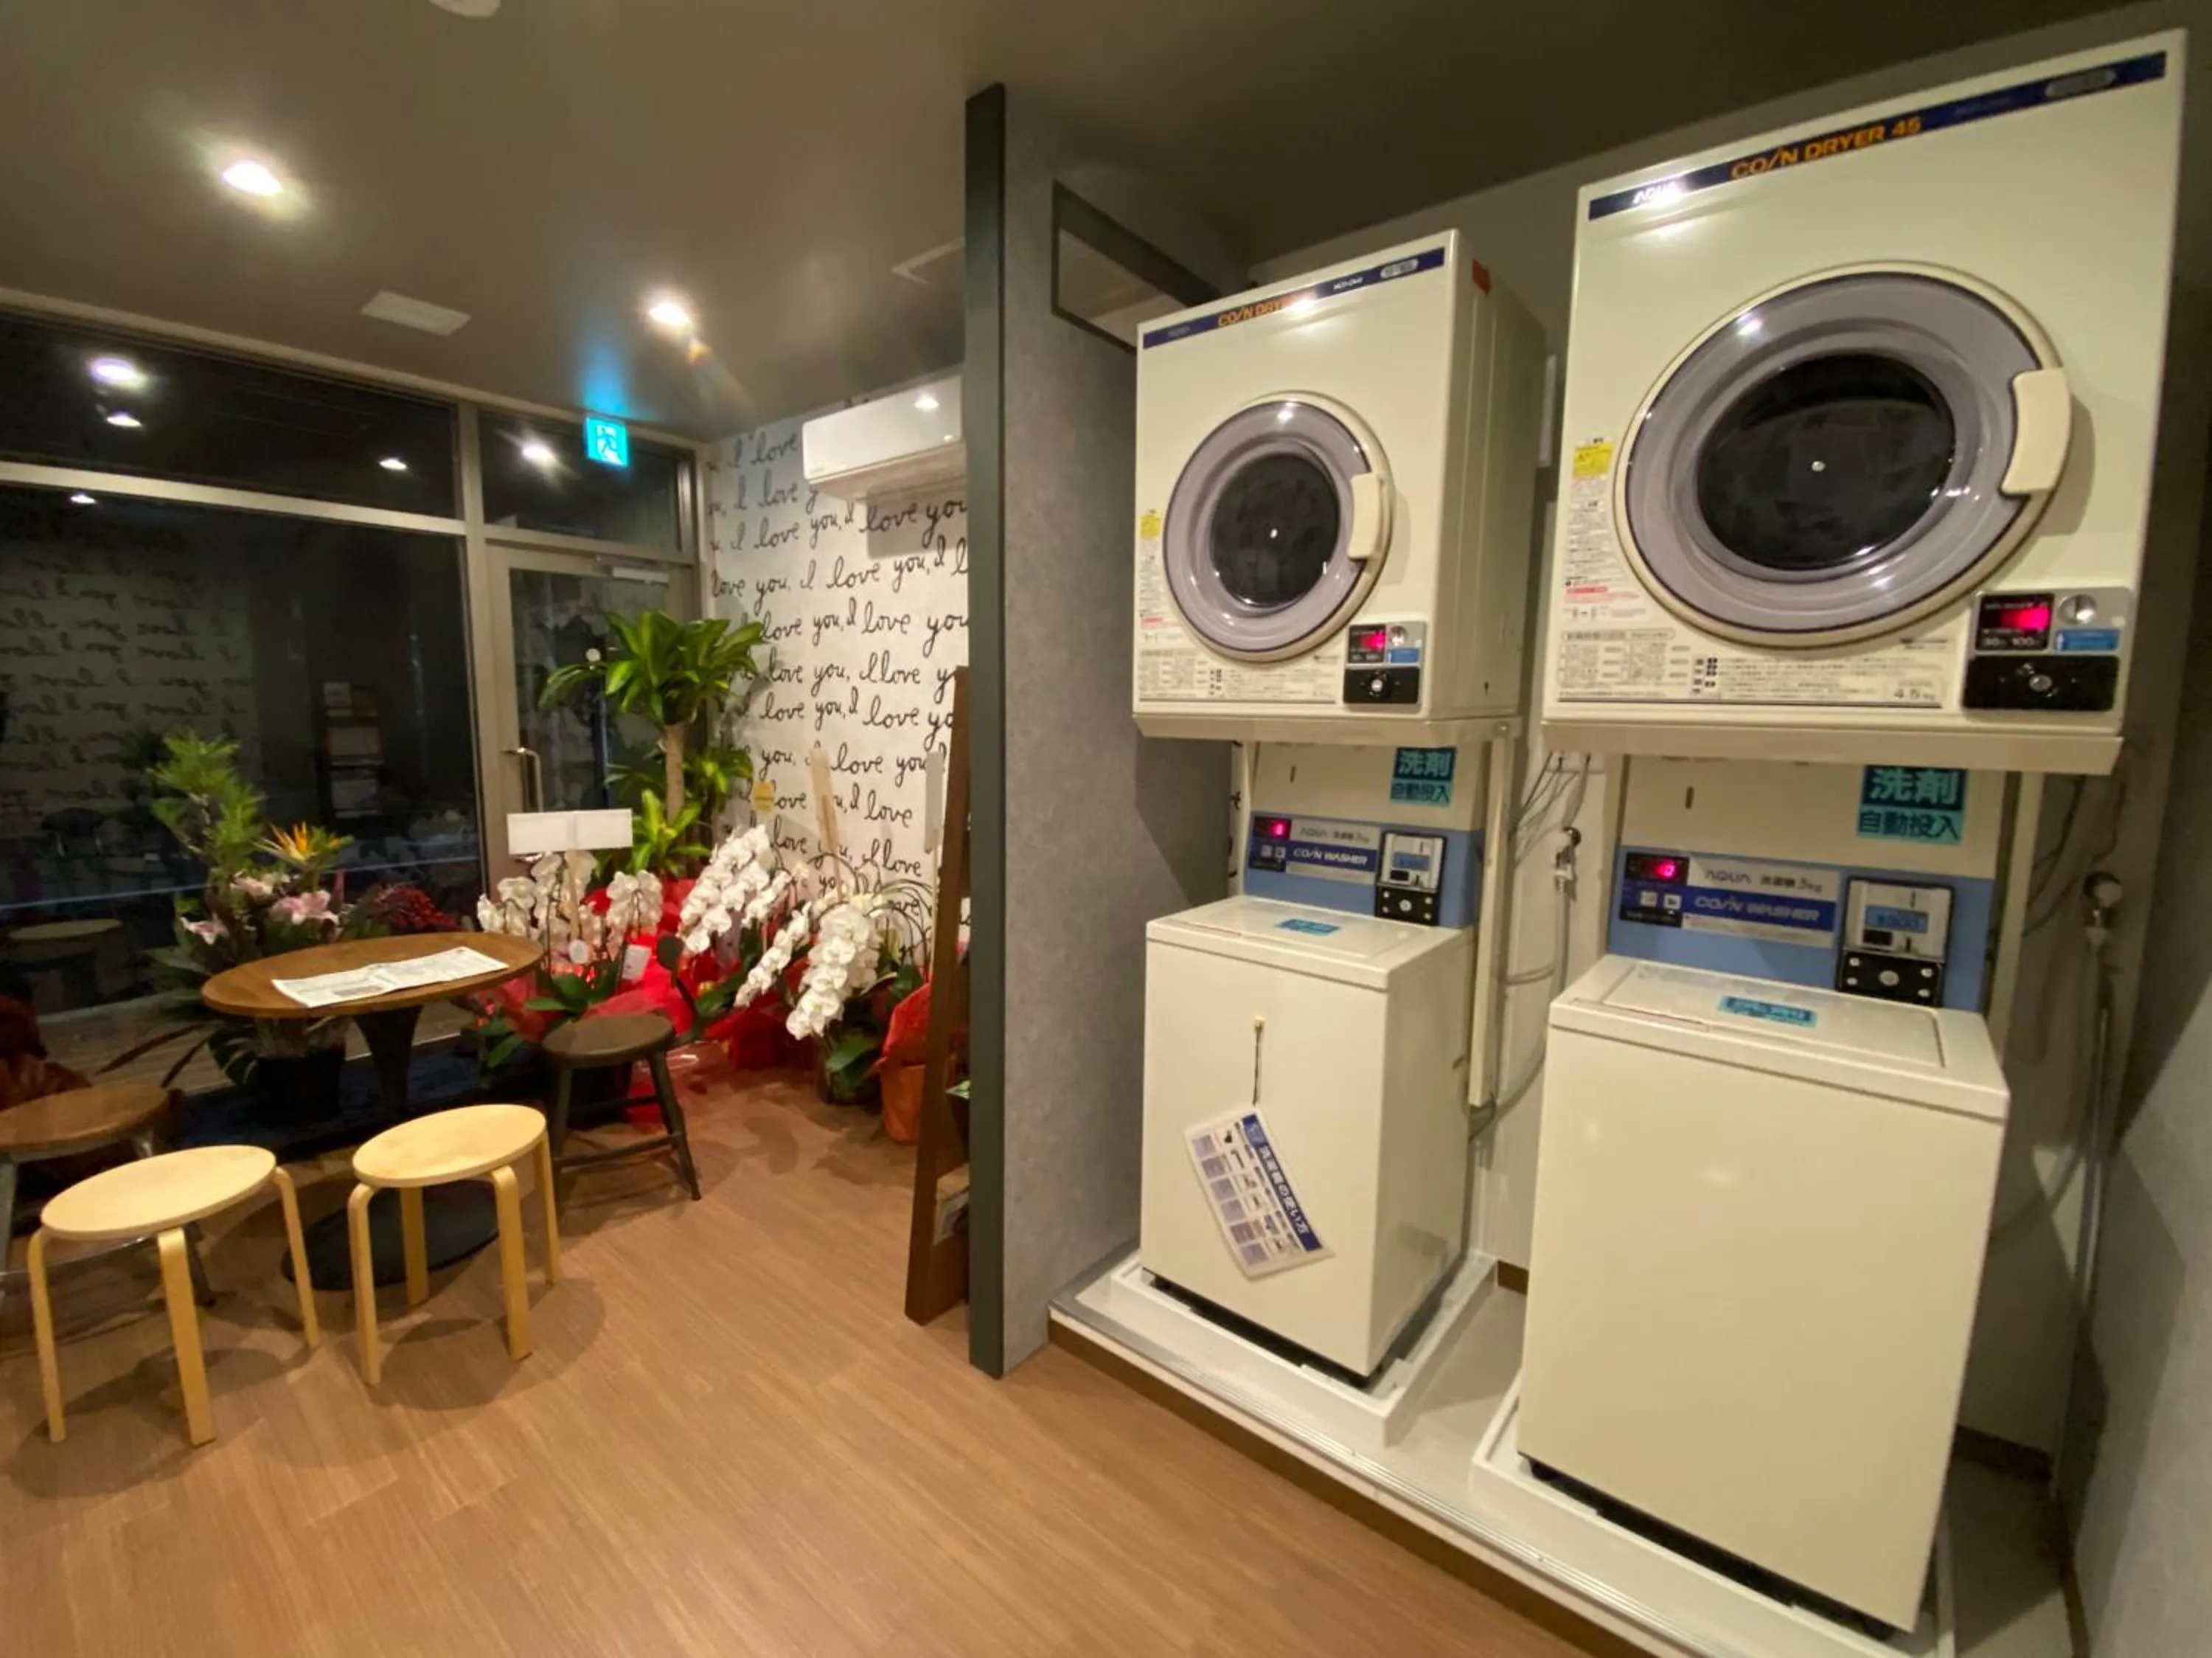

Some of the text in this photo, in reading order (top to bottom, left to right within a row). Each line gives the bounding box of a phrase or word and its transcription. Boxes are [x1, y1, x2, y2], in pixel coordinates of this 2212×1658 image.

[1804, 125, 1885, 162] DRYER
[1890, 116, 1923, 138] 45
[757, 469, 799, 507] love
[754, 518, 801, 549] love
[858, 502, 918, 533] love
[826, 555, 880, 589] love
[760, 611, 802, 640] love
[861, 601, 911, 634] love
[764, 647, 804, 683] love
[880, 649, 921, 684] love
[759, 691, 804, 721] love
[863, 695, 920, 729] love
[831, 740, 884, 772] love
[1870, 768, 1960, 805] 洗剤
[863, 790, 914, 828] love
[771, 813, 808, 855] love
[882, 839, 922, 877] love
[1746, 903, 1821, 923] WASHER
